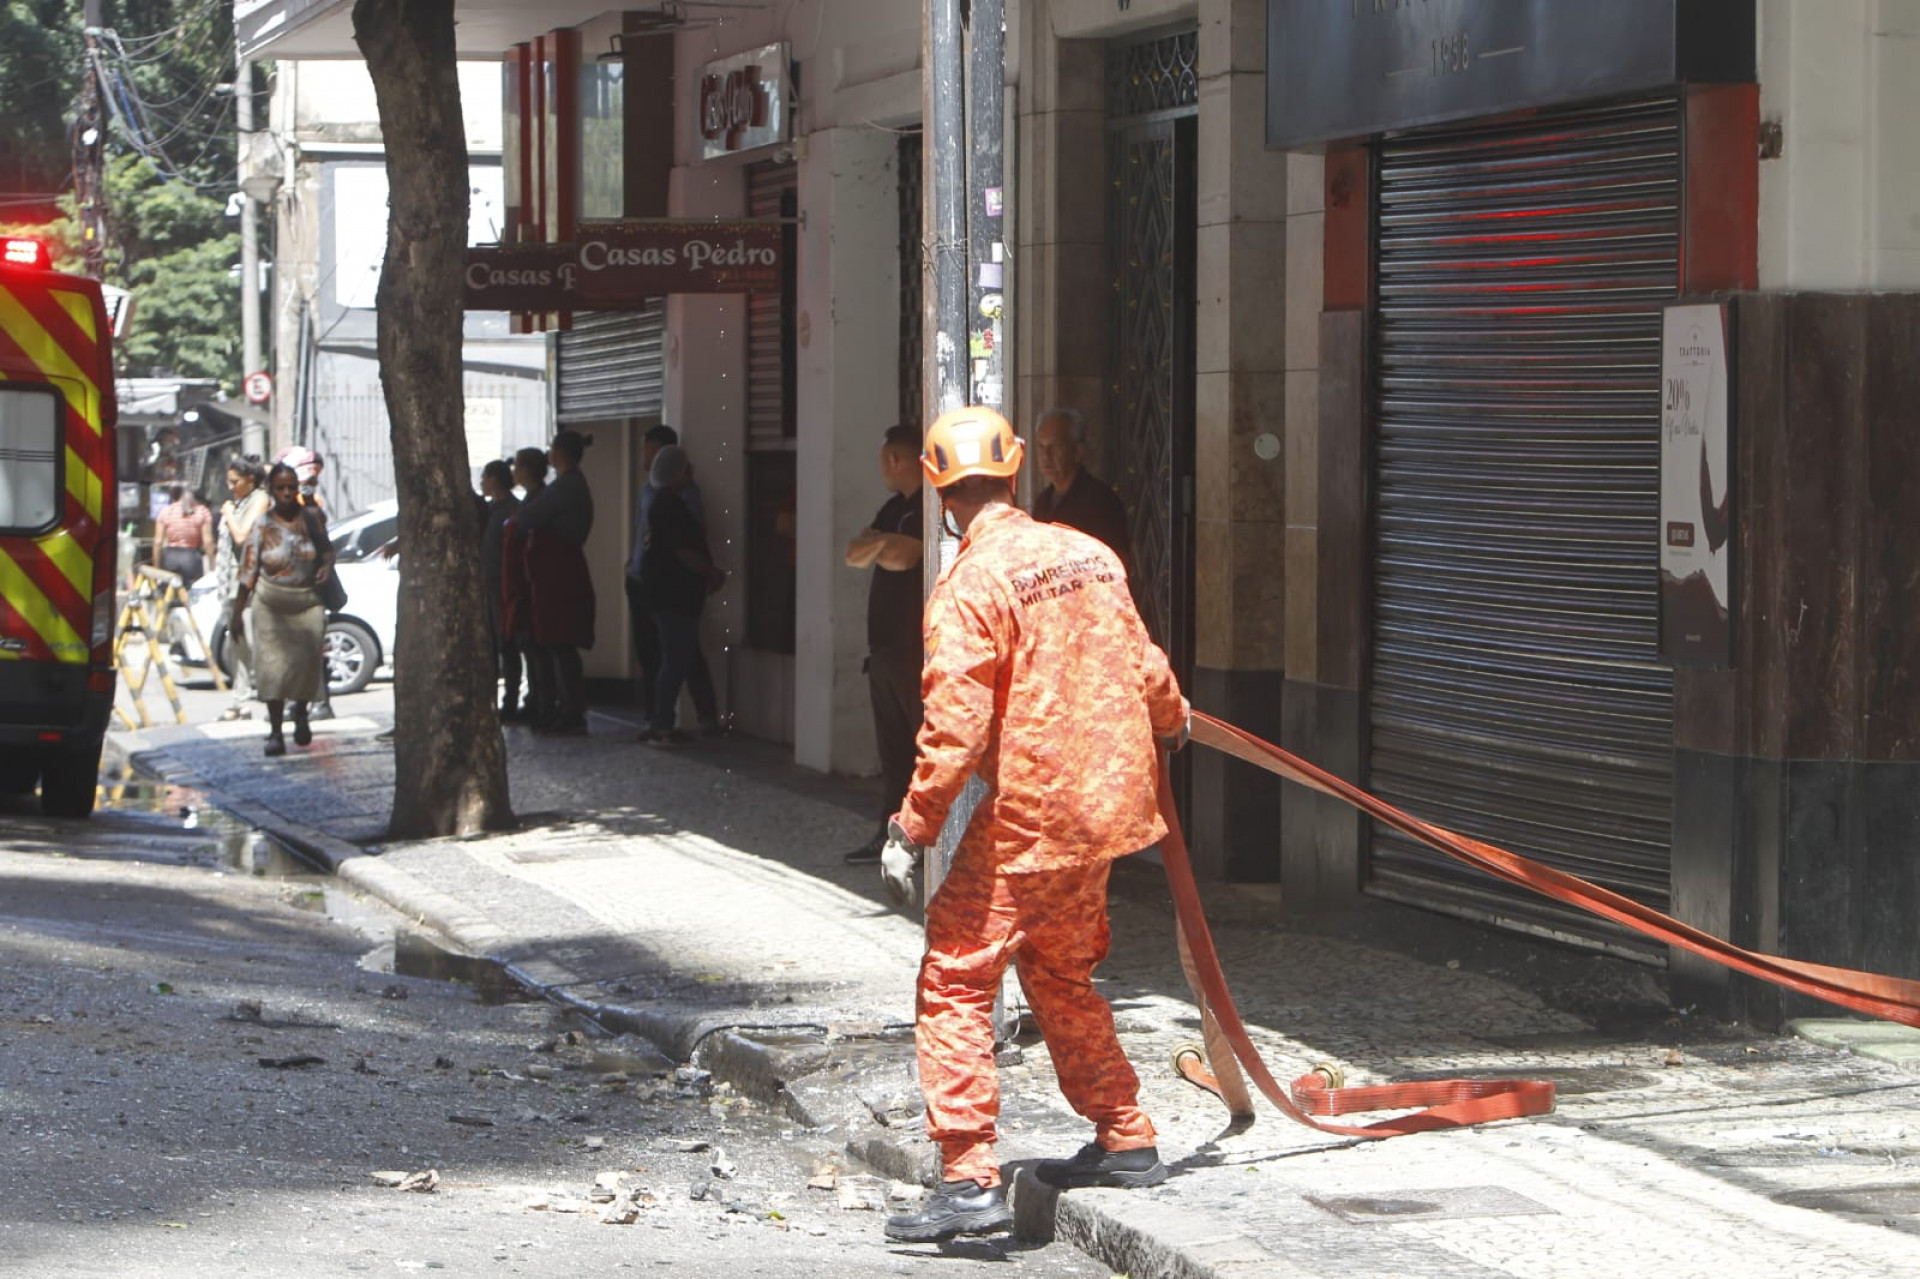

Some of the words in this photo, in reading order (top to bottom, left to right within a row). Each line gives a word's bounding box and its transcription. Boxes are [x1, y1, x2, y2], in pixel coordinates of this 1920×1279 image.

[1432, 33, 1469, 76] 1958
[580, 241, 677, 270] Casas
[682, 239, 777, 270] Pedro
[465, 263, 550, 289] Casas
[1666, 378, 1690, 411] 20%
[1019, 579, 1084, 608] MILITAR
